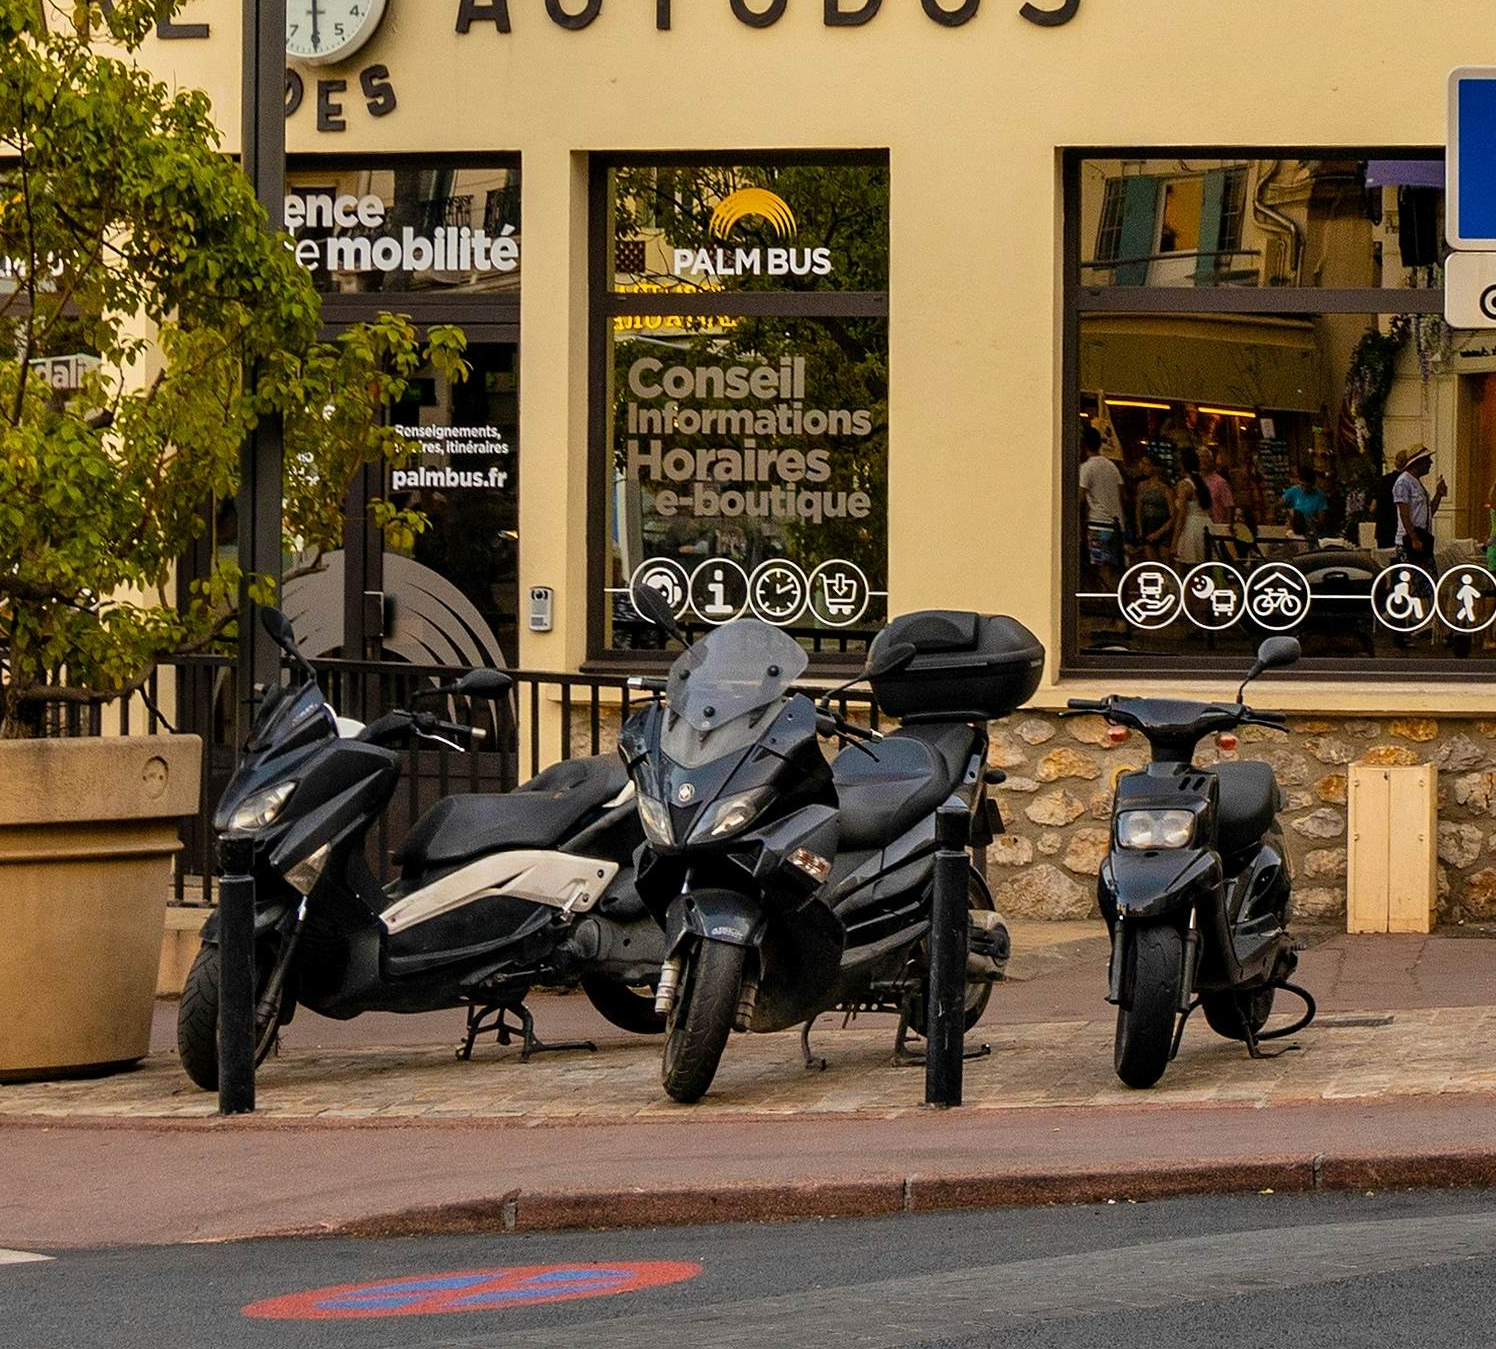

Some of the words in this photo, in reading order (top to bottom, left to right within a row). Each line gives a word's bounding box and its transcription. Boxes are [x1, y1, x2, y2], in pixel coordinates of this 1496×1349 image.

[284, 194, 385, 228] ence
[327, 225, 519, 272] mobilité
[673, 247, 760, 276] PALM
[767, 247, 833, 276] BUS
[628, 356, 806, 400] Conseil
[396, 423, 501, 440] Renseignements,
[627, 401, 872, 436] Informations
[446, 438, 510, 455] itinéraires
[626, 438, 832, 483] Horaires
[392, 466, 508, 491] palmbus.fr
[656, 482, 872, 524] e-boutique
